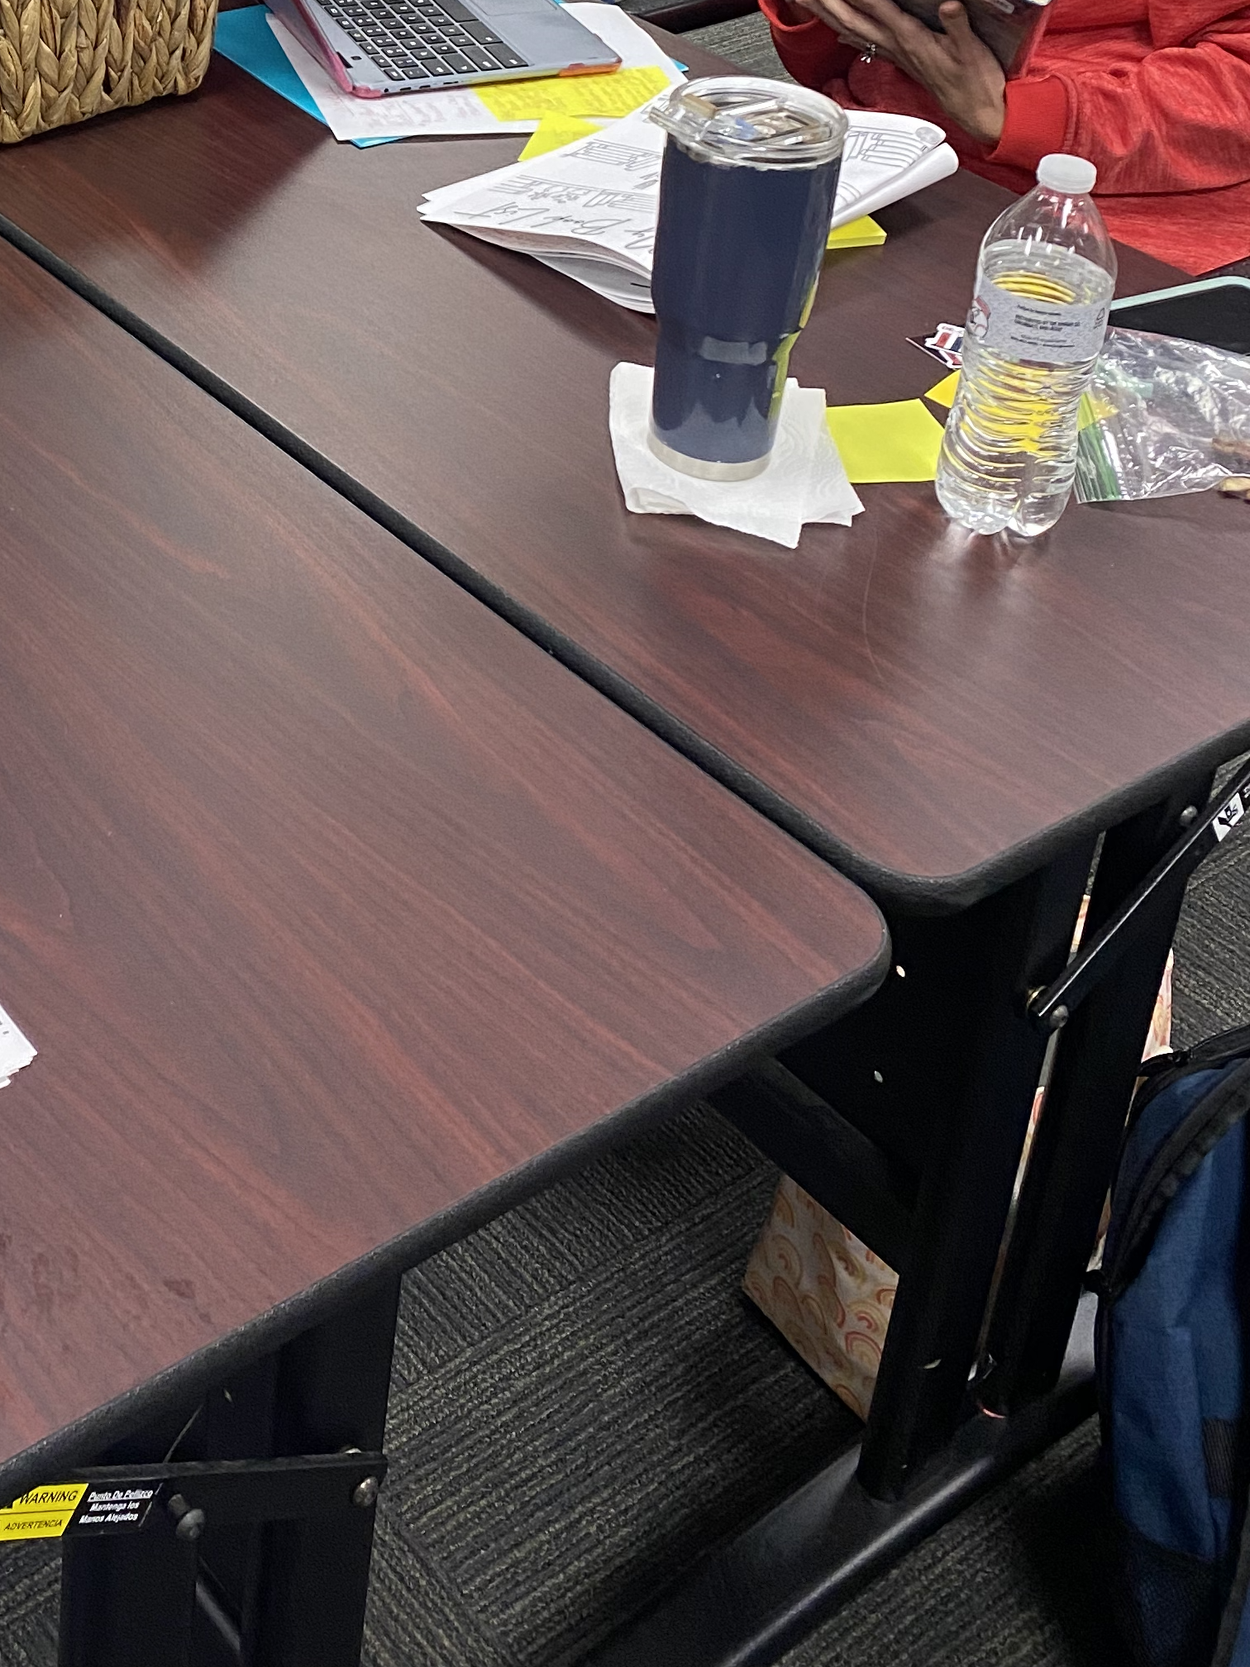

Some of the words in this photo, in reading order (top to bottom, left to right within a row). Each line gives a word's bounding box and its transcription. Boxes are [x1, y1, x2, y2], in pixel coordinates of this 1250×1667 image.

[19, 1490, 79, 1506] WARNING
[3, 1519, 64, 1531] ADVERTENCIA
[78, 1514, 105, 1524] Manos
